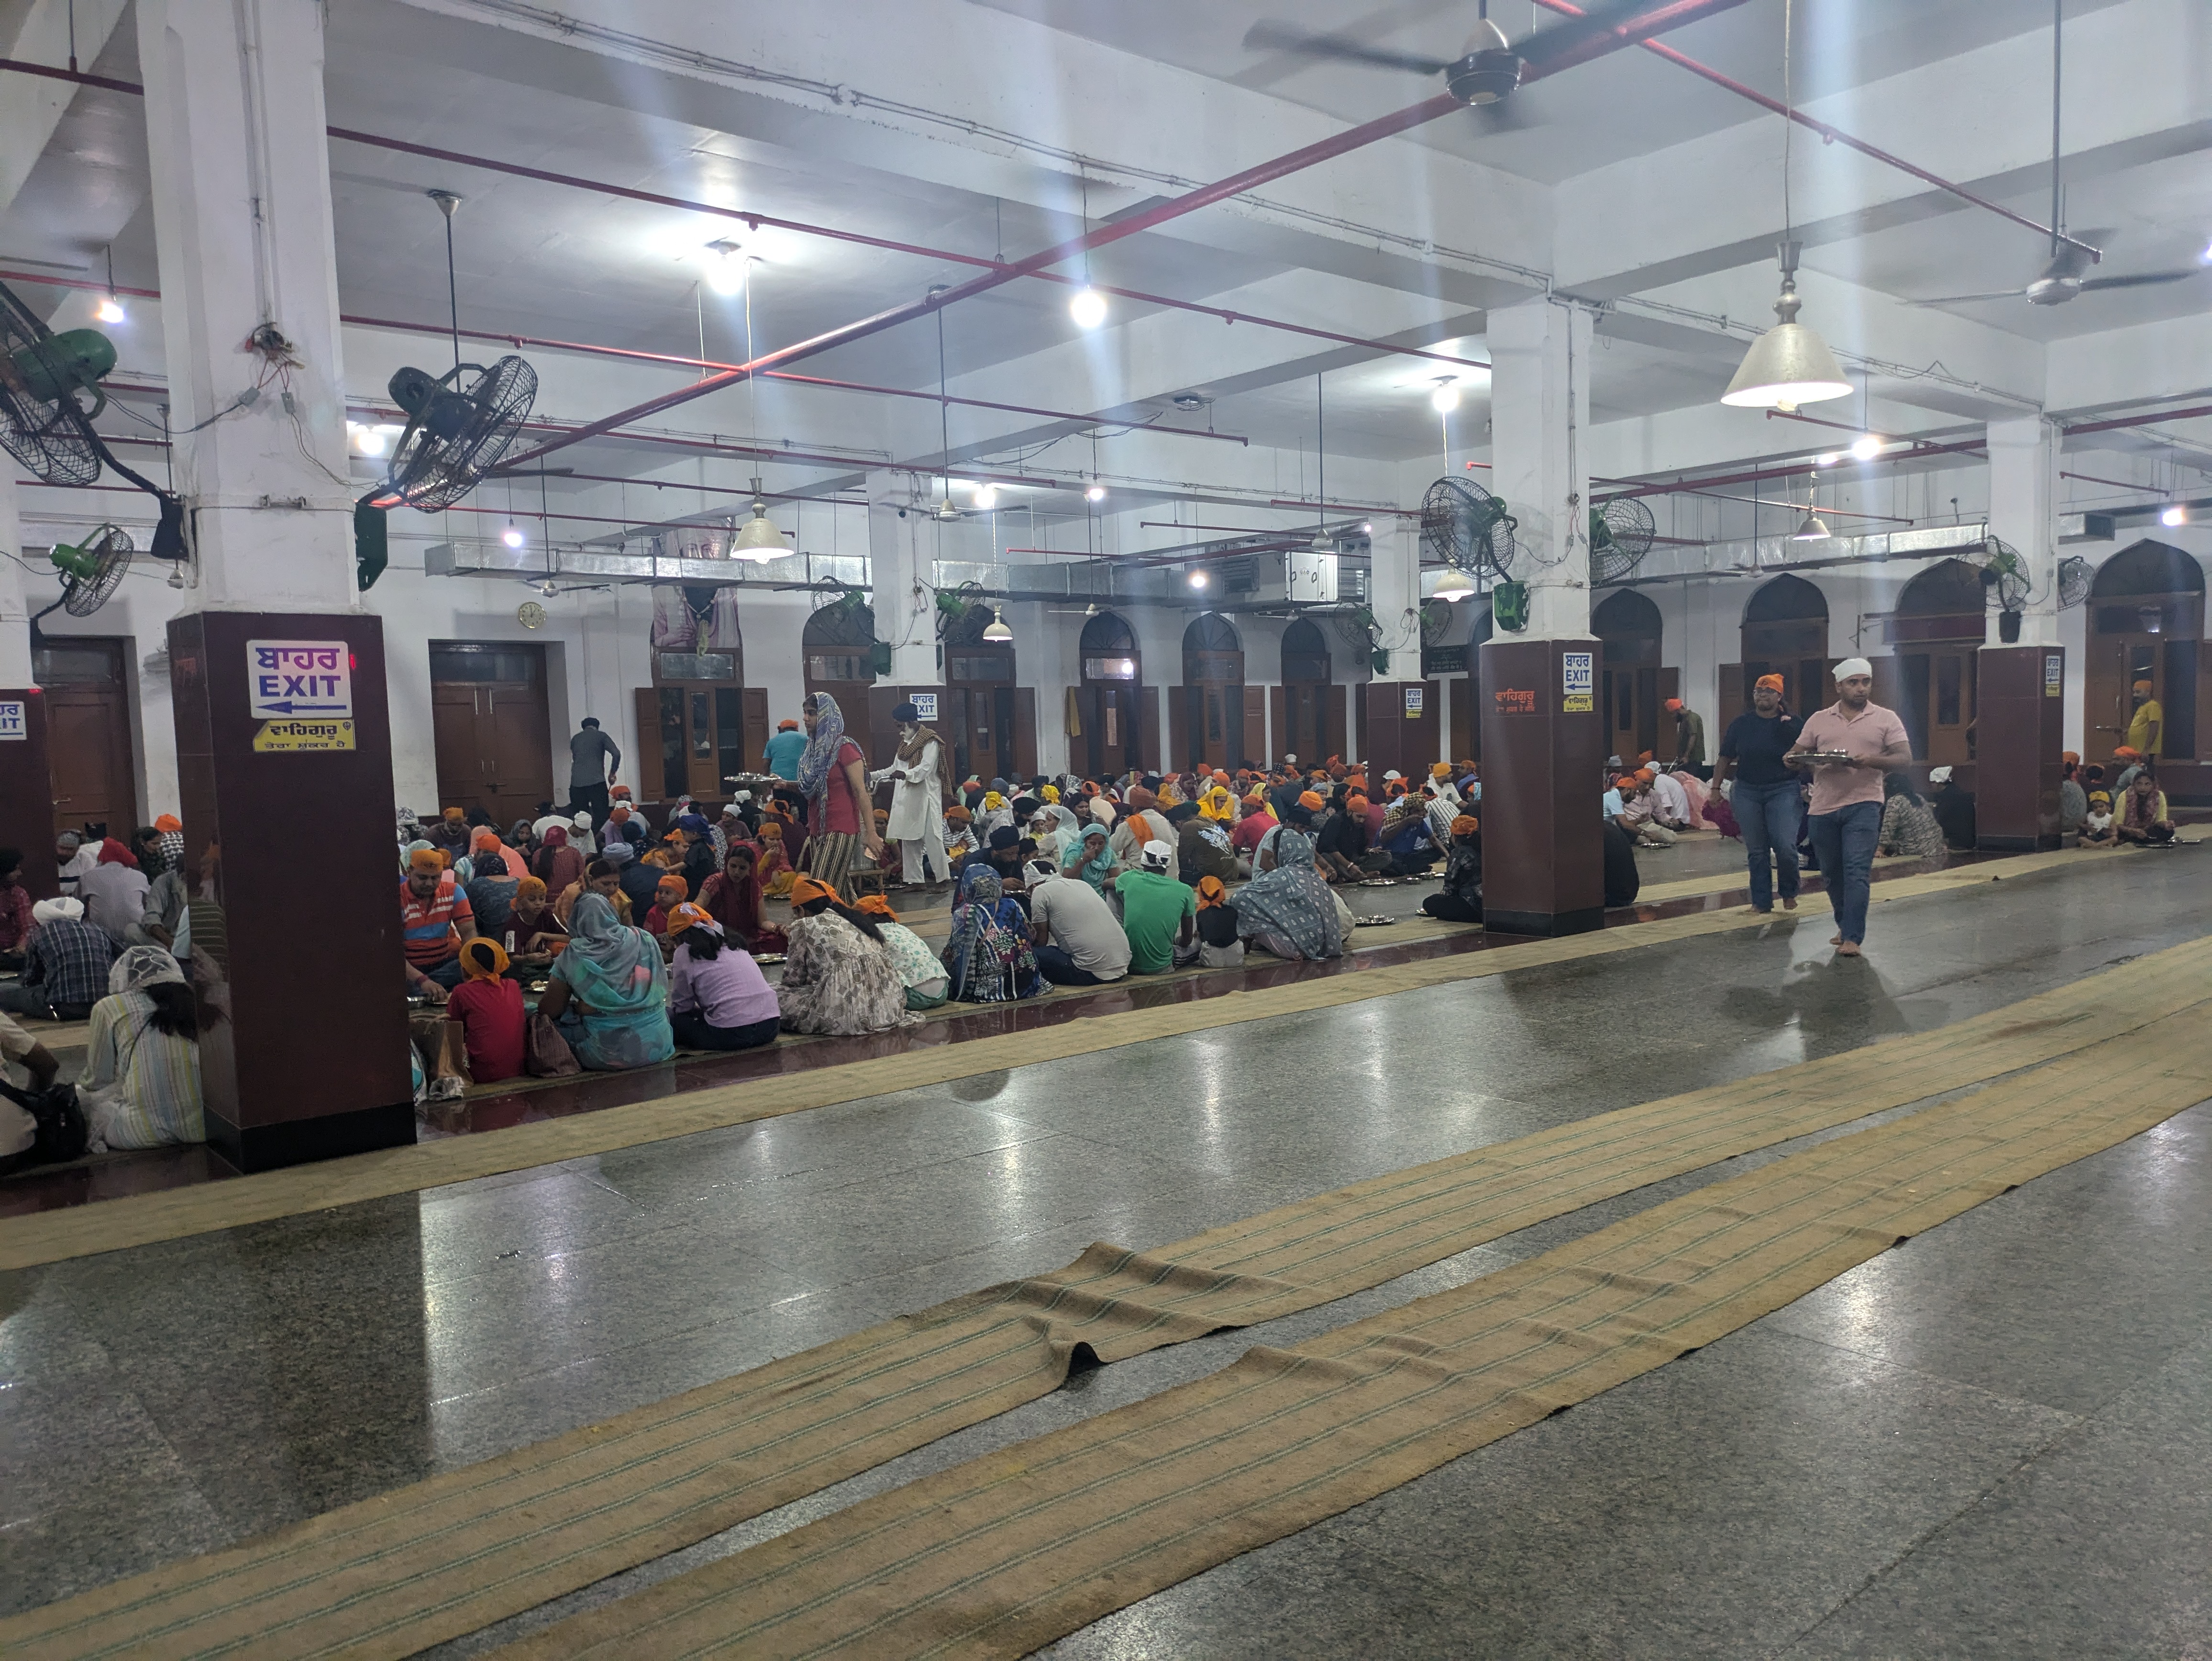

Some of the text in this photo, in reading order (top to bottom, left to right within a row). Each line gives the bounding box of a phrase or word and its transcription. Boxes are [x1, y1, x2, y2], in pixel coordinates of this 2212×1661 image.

[255, 648, 340, 670] ਬਾਹਰ
[1565, 655, 1590, 667] ਬਾਹਰ
[1566, 670, 1590, 681] EXIT
[259, 675, 341, 697] EXIT
[0, 718, 20, 729] IT
[269, 723, 337, 740] ਵਾਹਿਗੁਰੂ
